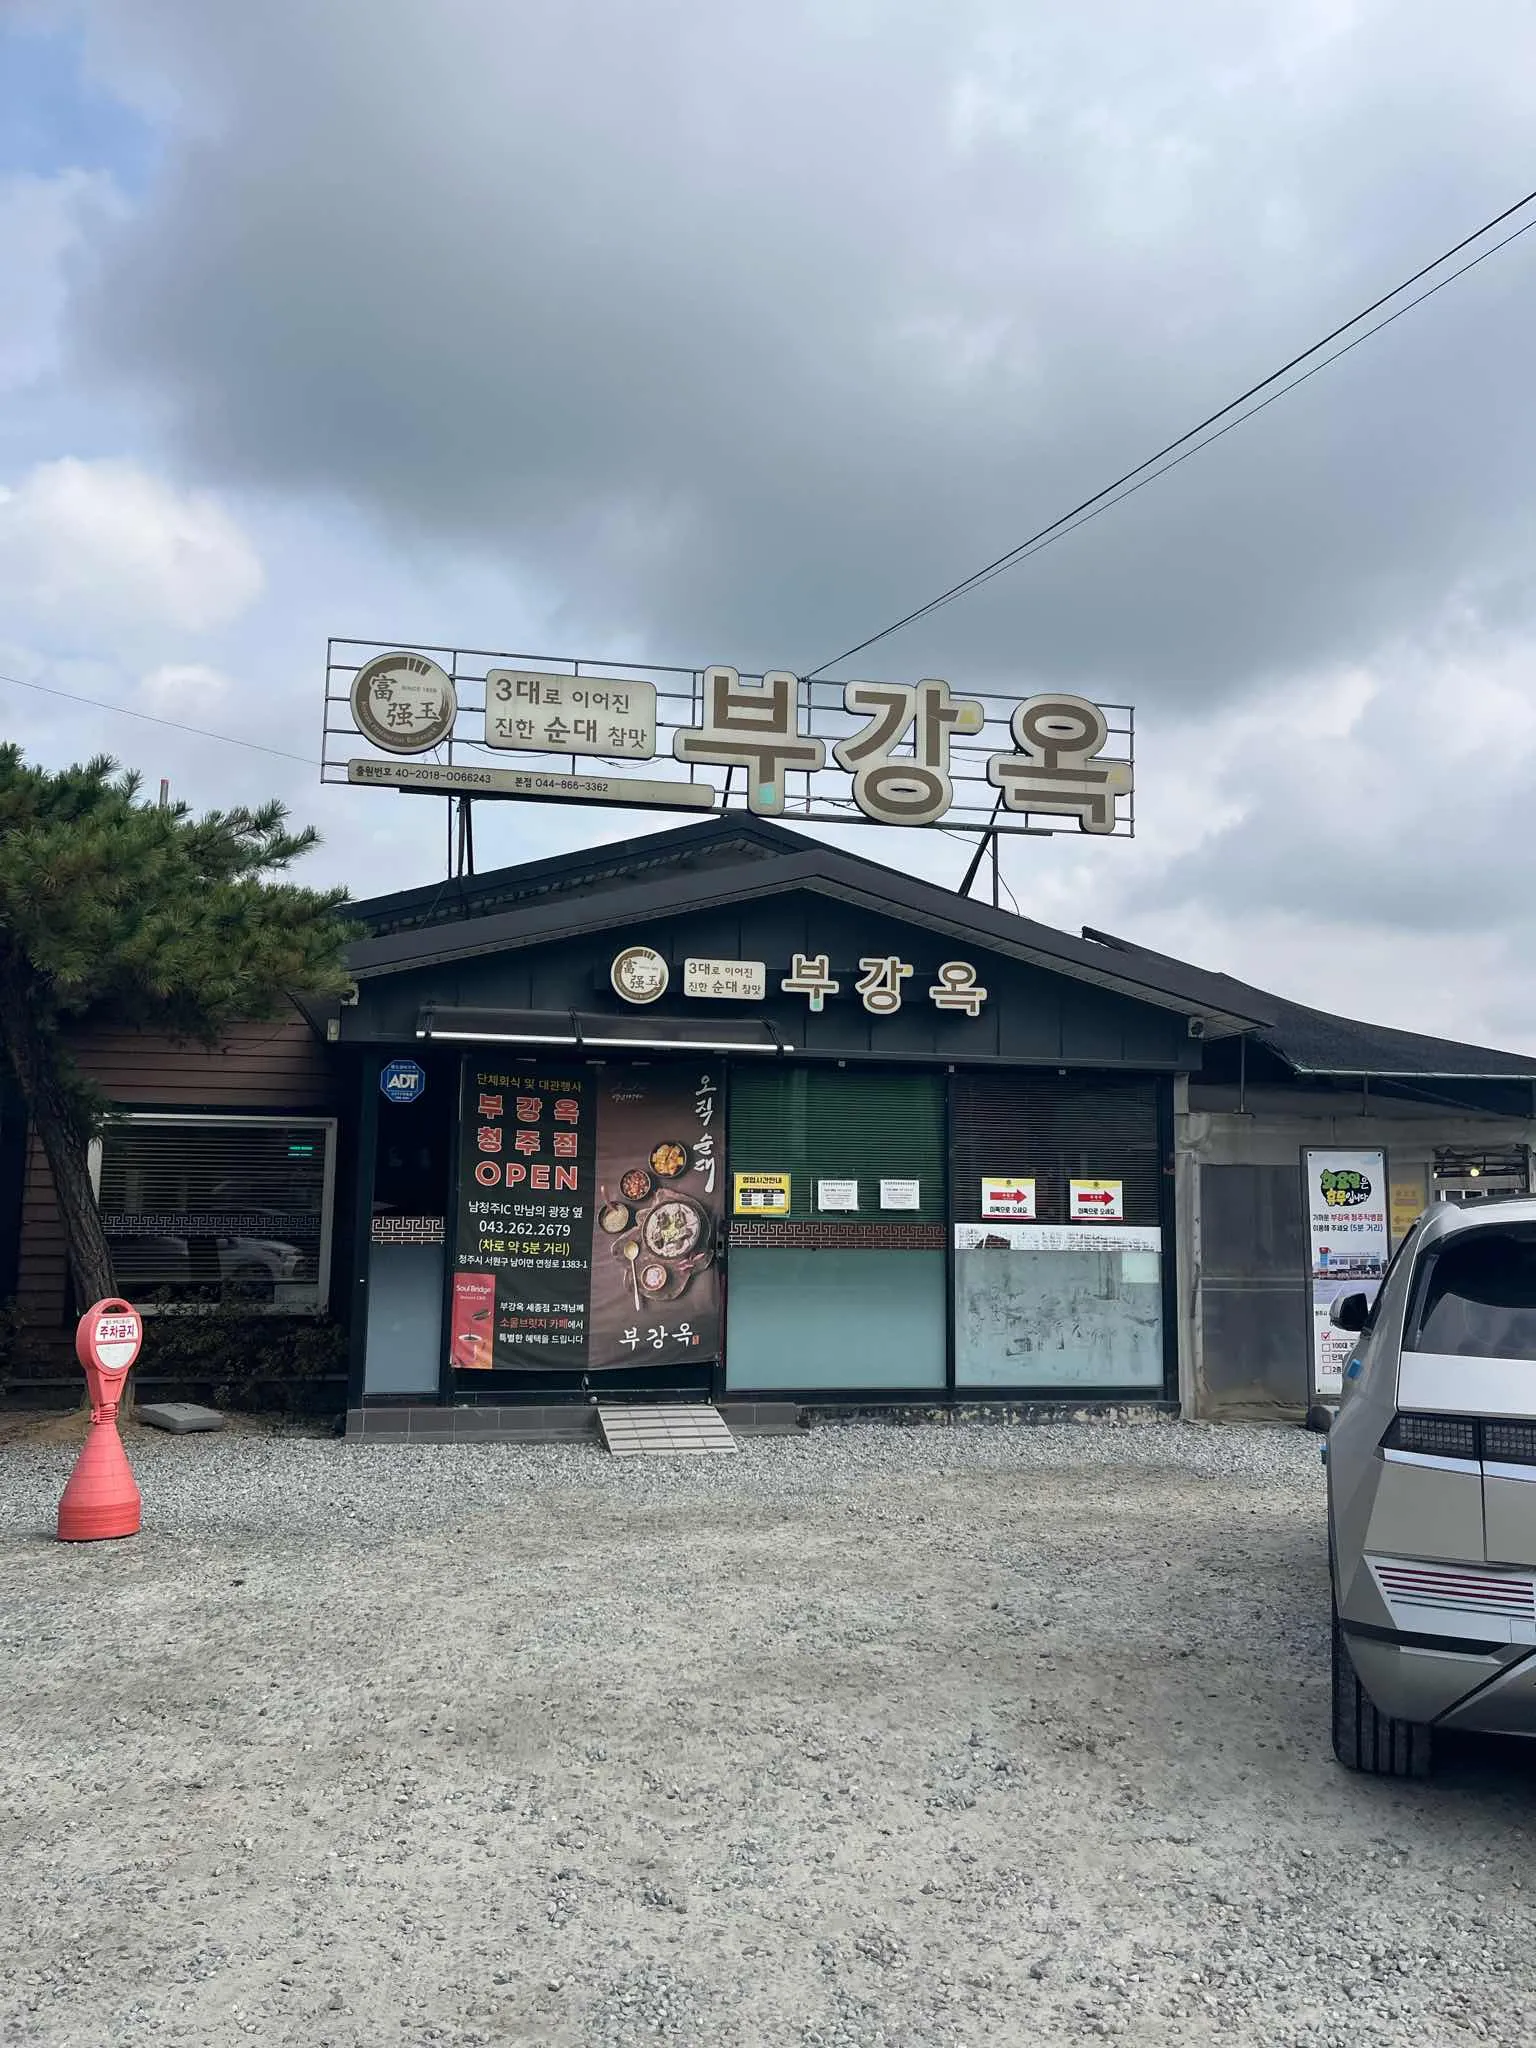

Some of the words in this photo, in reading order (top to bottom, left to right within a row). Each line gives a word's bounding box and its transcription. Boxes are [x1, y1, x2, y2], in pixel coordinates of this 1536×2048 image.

[495, 678, 562, 705] 3대로
[572, 691, 630, 715] 이어진
[495, 717, 535, 740] 진한
[544, 716, 597, 744] 순대
[607, 725, 648, 750] 참맛
[673, 665, 1133, 834] 부강옥
[356, 765, 392, 778] 출원번호
[395, 767, 492, 784] 40-2018-0066243
[514, 776, 533, 788] 본점
[535, 779, 609, 792] 044-866-3362
[688, 962, 721, 975] 3대로
[724, 967, 753, 979] 이어진
[688, 981, 708, 993] 진한
[712, 980, 738, 994] 순대
[741, 984, 761, 996] 참맛
[781, 953, 987, 1016] 부강옥
[387, 1073, 419, 1089] ADT
[477, 1072, 520, 1088] 단체회식
[524, 1078, 535, 1090] 및
[538, 1079, 581, 1092] 대관행사
[695, 1075, 717, 1126] 오직
[692, 1133, 716, 1193] 순대
[475, 1160, 578, 1191] OPEN
[468, 1200, 512, 1215] 남청주IC
[513, 1203, 546, 1217] 만남의
[548, 1206, 570, 1219] 광장
[572, 1206, 583, 1219] 옆
[479, 1220, 571, 1237] 043.262.2679
[1366, 1223, 1384, 1232] 거리)
[478, 1239, 505, 1253] (차로
[507, 1240, 520, 1254] 약
[522, 1242, 541, 1255] 5분
[543, 1242, 571, 1256] 거리)
[458, 1254, 483, 1265] 청주시
[484, 1256, 509, 1267] 서원구
[510, 1258, 534, 1268] 남이면
[561, 1259, 588, 1269] 1383-1
[499, 1302, 524, 1312] 부강옥
[526, 1303, 550, 1313] 세종점
[552, 1303, 584, 1313] 고객님께
[100, 1324, 135, 1339] 주차금지
[499, 1317, 547, 1329] 소울브릿지
[499, 1332, 524, 1344] 특별한
[526, 1334, 549, 1344] 혜택을
[551, 1334, 584, 1345] 드립니다
[618, 1322, 693, 1352] 부강옥
